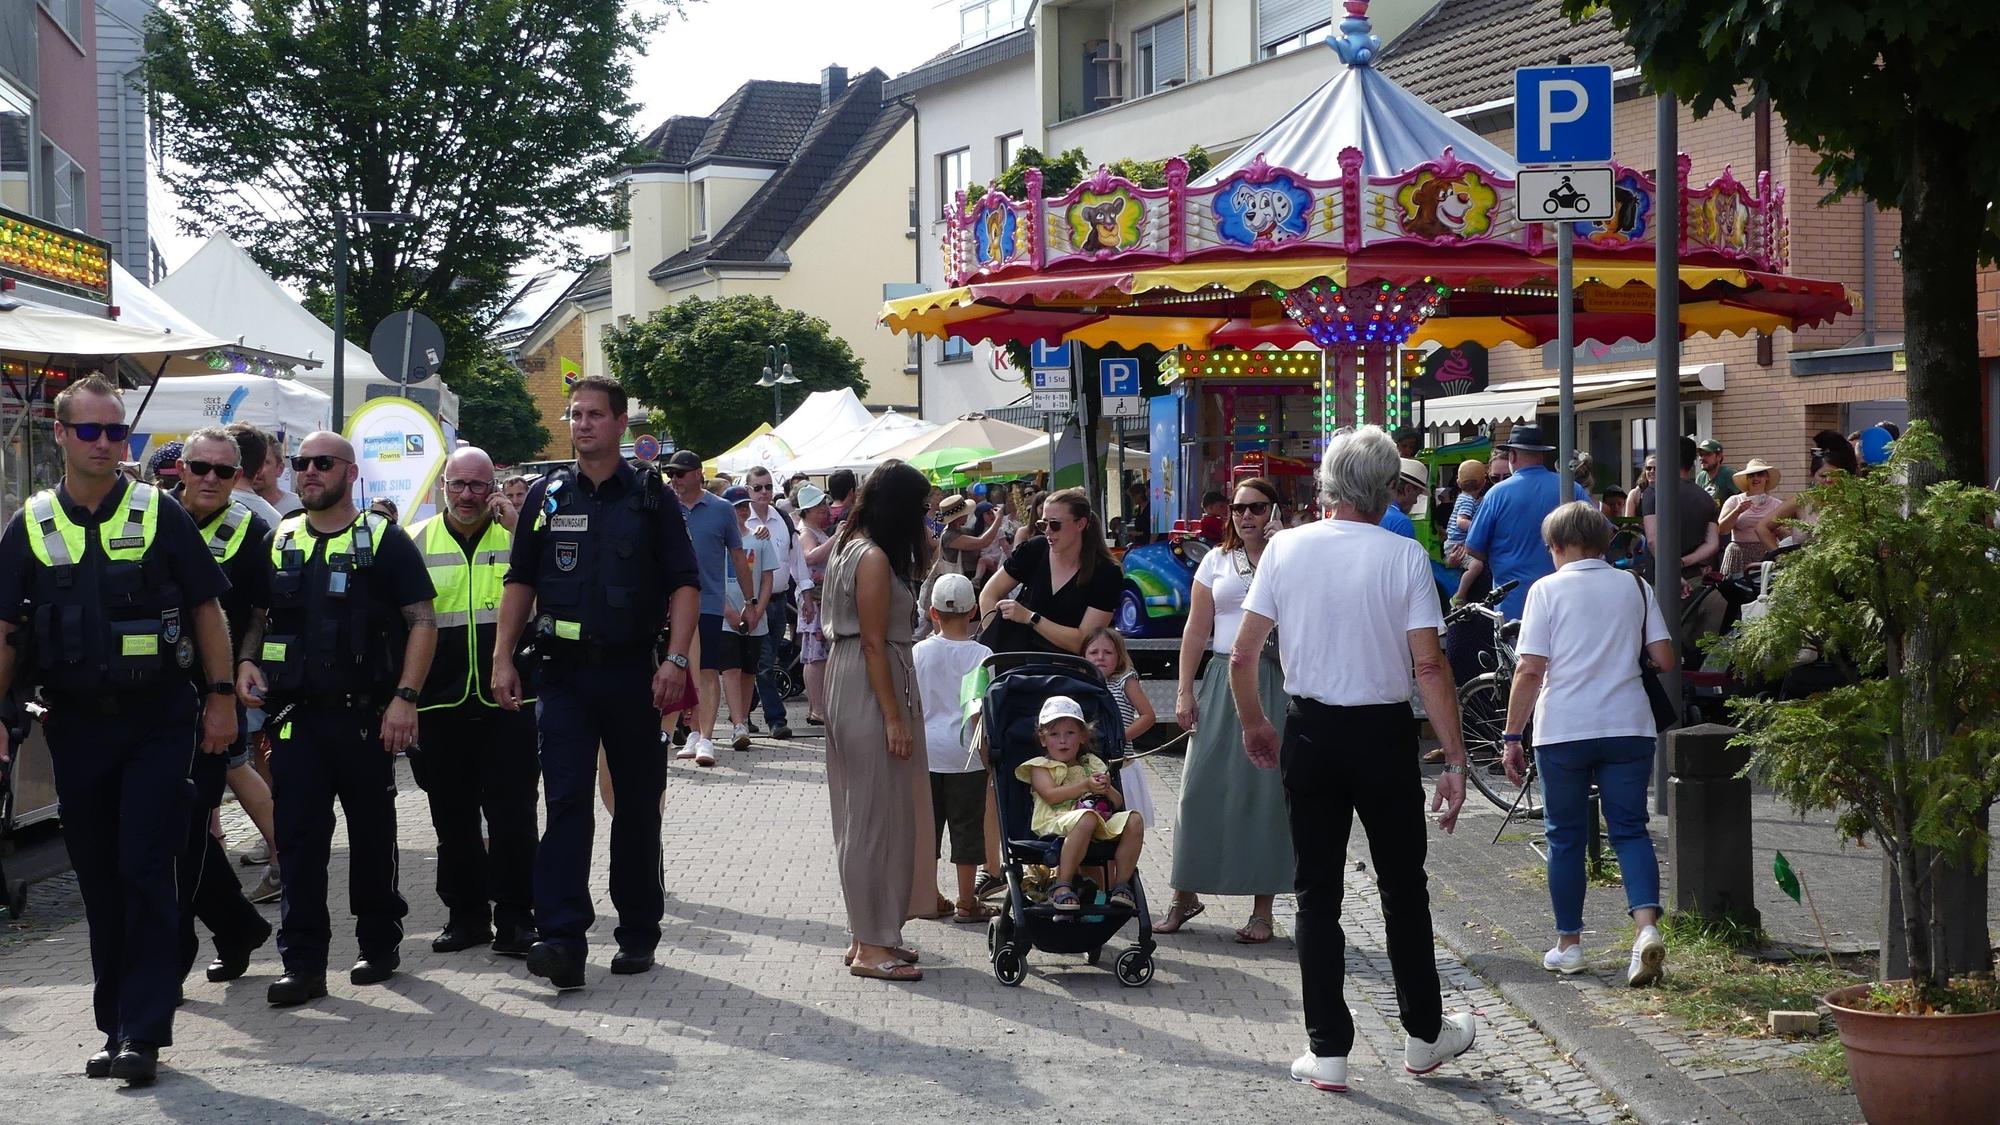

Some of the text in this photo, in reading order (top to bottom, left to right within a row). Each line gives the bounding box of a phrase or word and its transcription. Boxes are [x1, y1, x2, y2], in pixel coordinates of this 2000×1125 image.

[1539, 79, 1589, 151] P
[1109, 364, 1130, 392] P
[379, 452, 401, 460] Towns
[368, 479, 411, 492] WIR SIND
[552, 517, 587, 528] ORDNUNGSAMT
